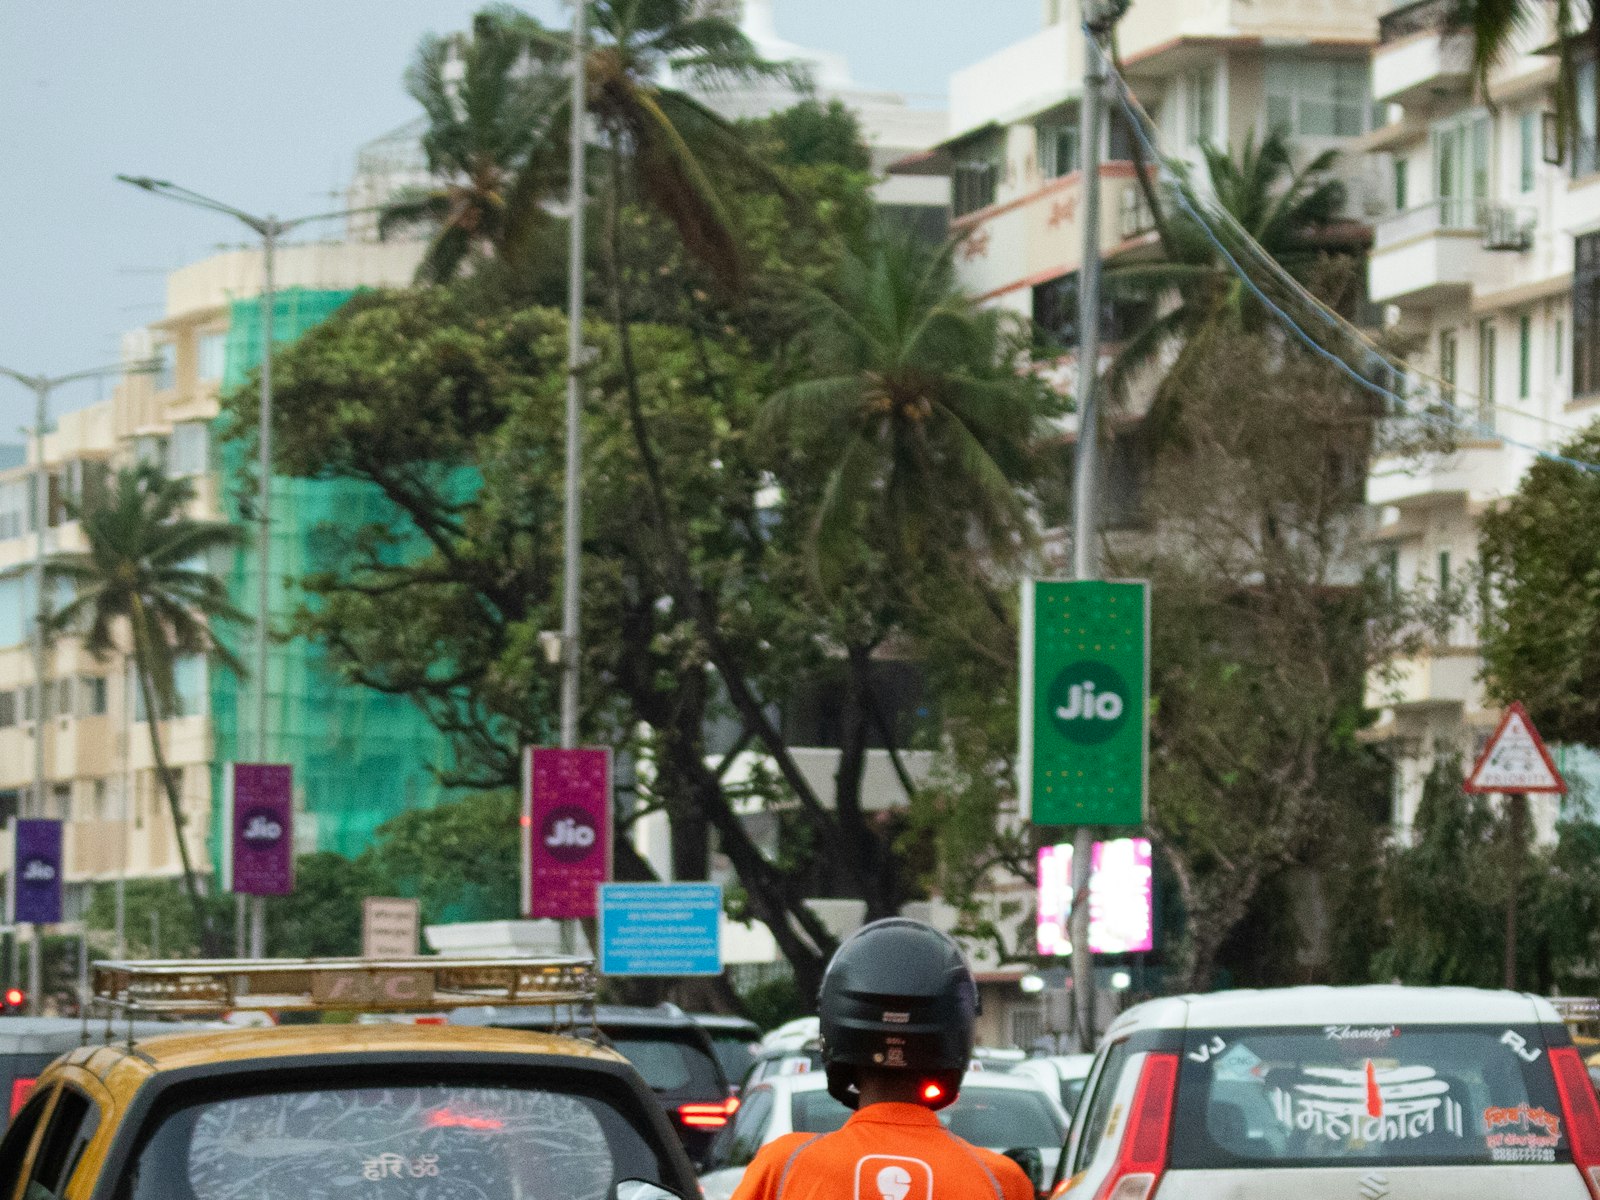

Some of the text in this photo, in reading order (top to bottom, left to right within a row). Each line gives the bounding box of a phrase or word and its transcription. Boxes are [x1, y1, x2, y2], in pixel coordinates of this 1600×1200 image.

[1056, 681, 1123, 720] Jio
[244, 816, 282, 839] Jio
[545, 818, 595, 846] Jio
[23, 860, 56, 880] Jio
